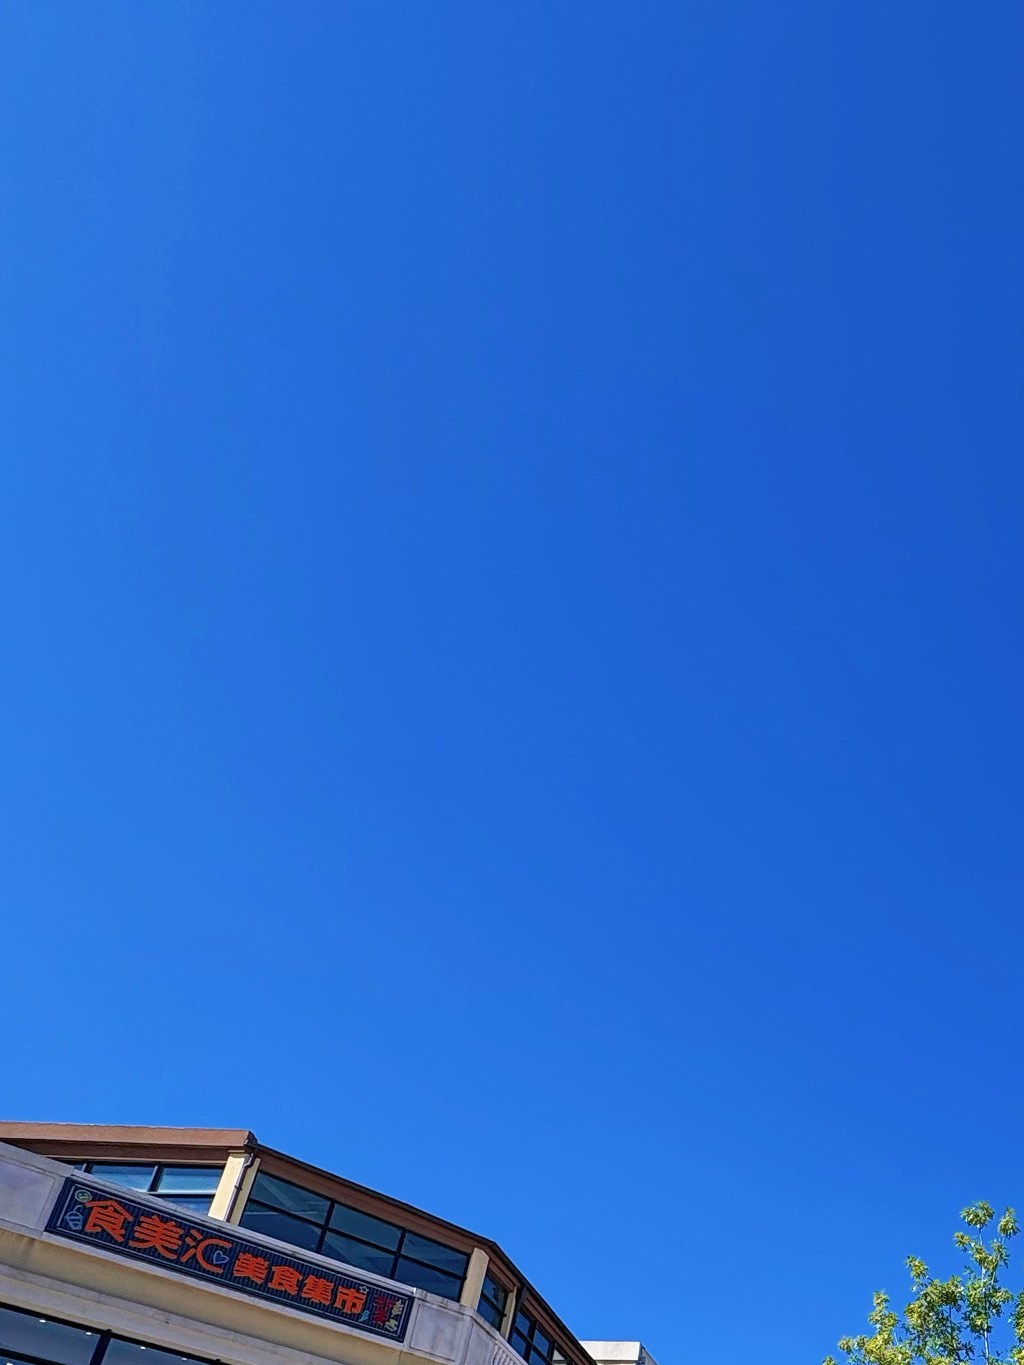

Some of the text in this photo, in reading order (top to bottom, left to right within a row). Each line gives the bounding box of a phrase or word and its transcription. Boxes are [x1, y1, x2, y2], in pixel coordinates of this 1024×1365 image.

[84, 1198, 233, 1275] 食美汇
[233, 1252, 370, 1316] 美食集市
